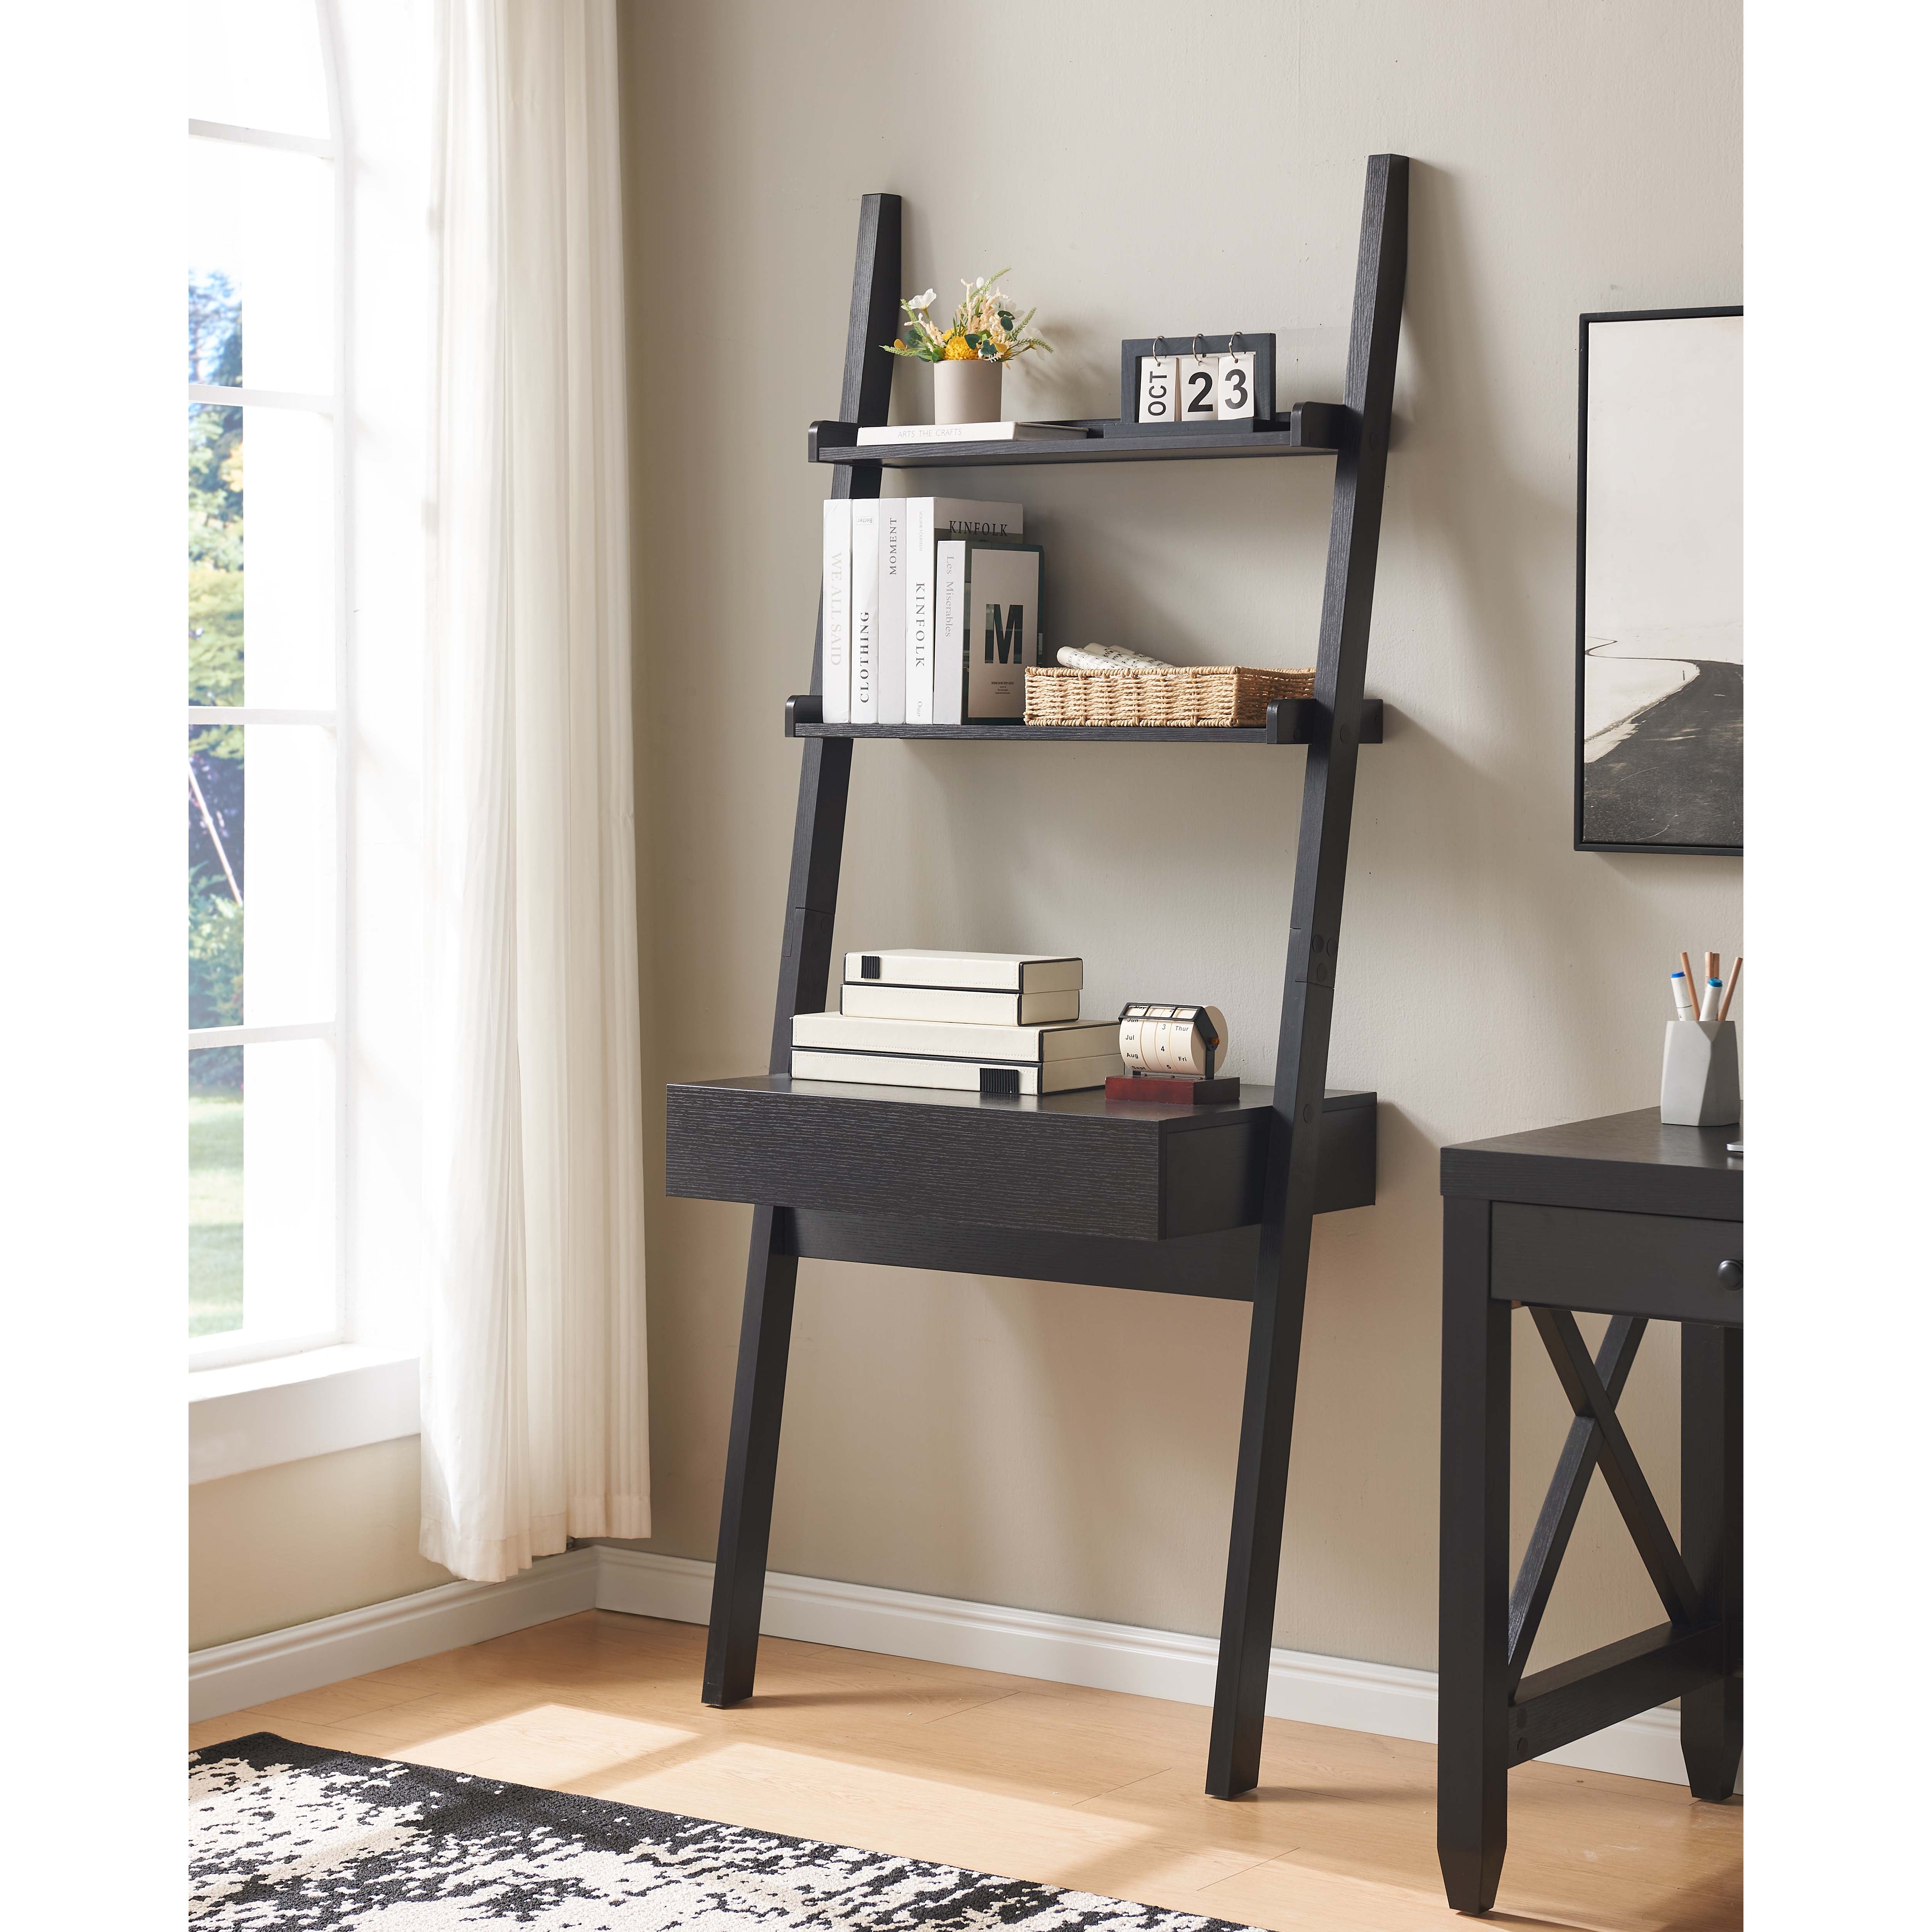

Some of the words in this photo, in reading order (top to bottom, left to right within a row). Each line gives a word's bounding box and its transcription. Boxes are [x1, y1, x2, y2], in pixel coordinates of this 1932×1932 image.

[1148, 371, 1167, 416] OCT
[949, 521, 1008, 536] KINFOLK
[831, 553, 842, 581] WE
[831, 585, 842, 620] ALL
[831, 624, 841, 666] SAID
[915, 582, 925, 668] KINFOLK
[985, 604, 1023, 664] M
[860, 611, 869, 703] CLOTHING
